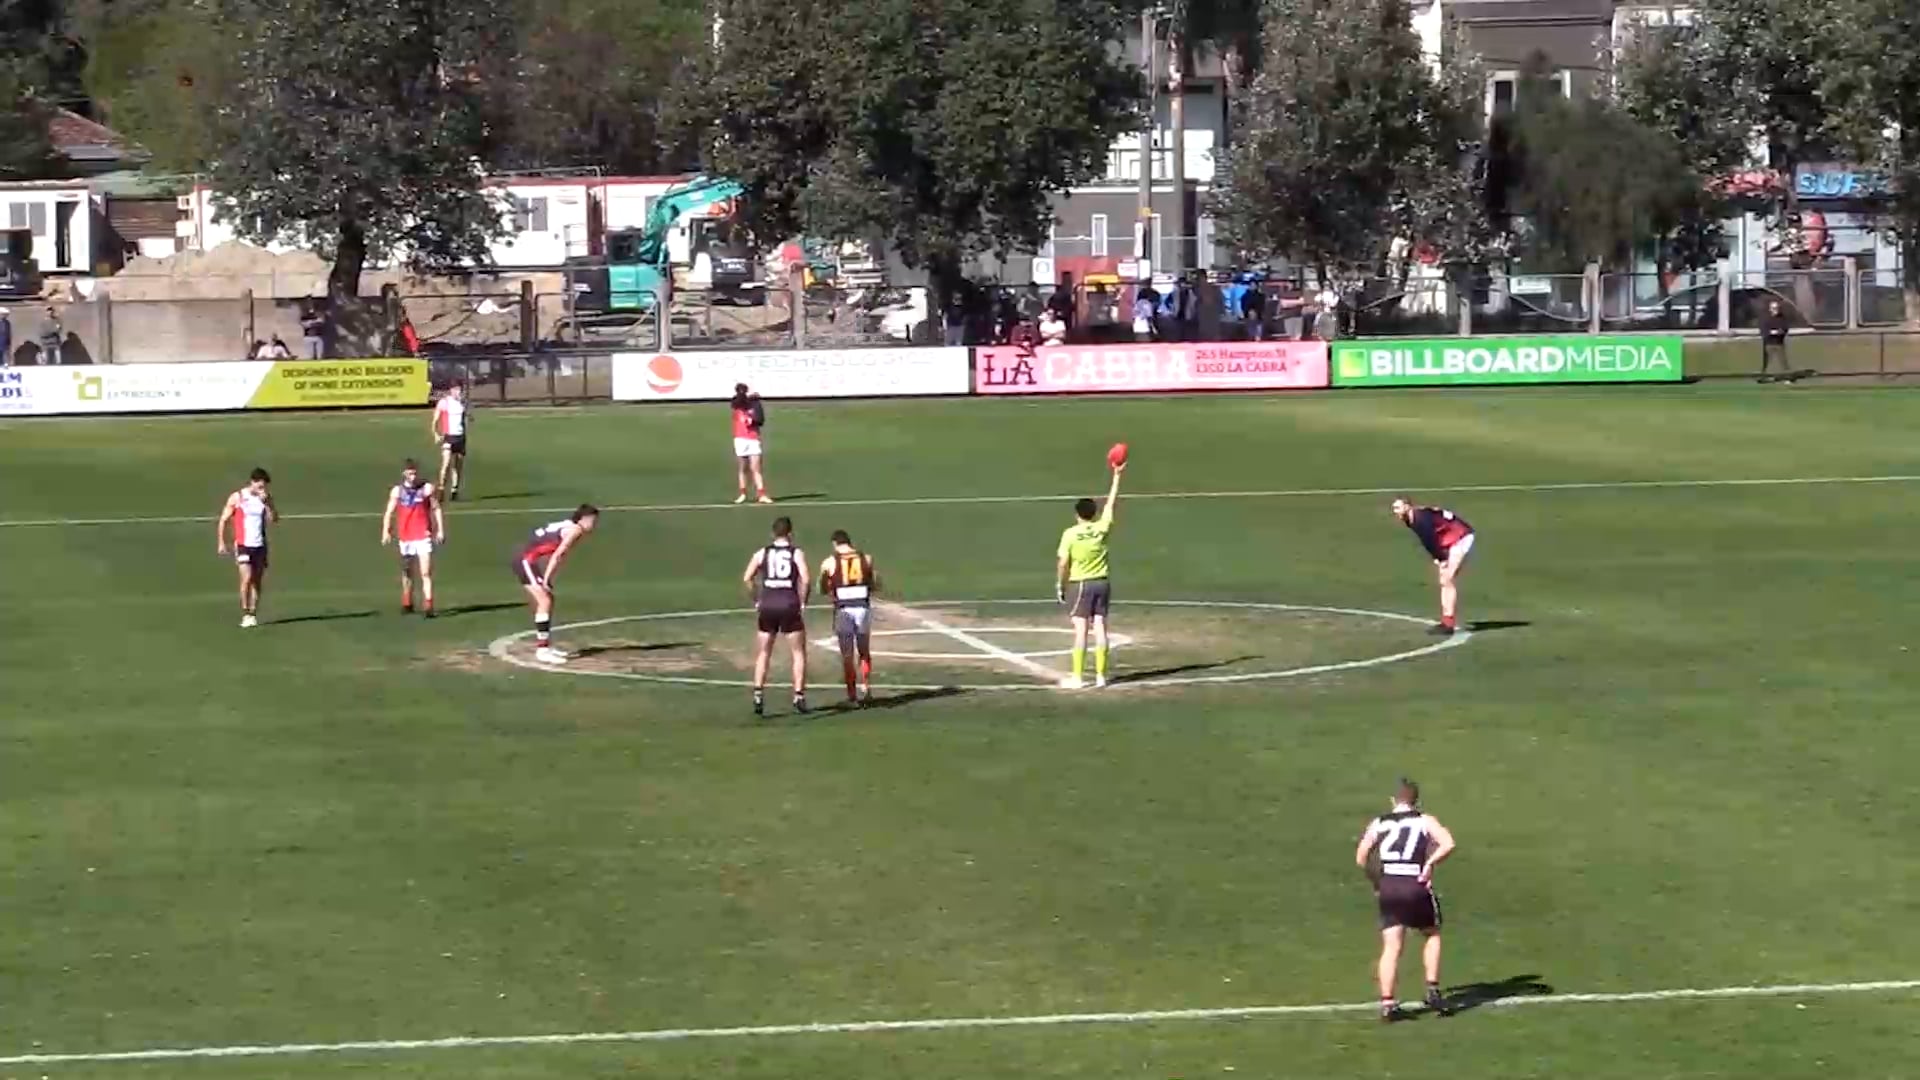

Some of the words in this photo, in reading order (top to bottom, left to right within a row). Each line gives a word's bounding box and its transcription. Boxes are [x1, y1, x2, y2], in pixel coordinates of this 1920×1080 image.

[341, 367, 362, 377] AND
[365, 365, 414, 376] BUILDERS
[983, 353, 1038, 386] LA
[1045, 350, 1193, 385] CABRA
[1227, 363, 1243, 373] LA
[1246, 362, 1287, 372] CABRA
[1370, 345, 1673, 376] BILLBOARDMEDIA
[310, 380, 338, 389] HOME
[341, 378, 404, 389] EXTENSIONS
[767, 548, 792, 579] 16
[841, 555, 863, 585] 14
[1379, 817, 1422, 861] 27
